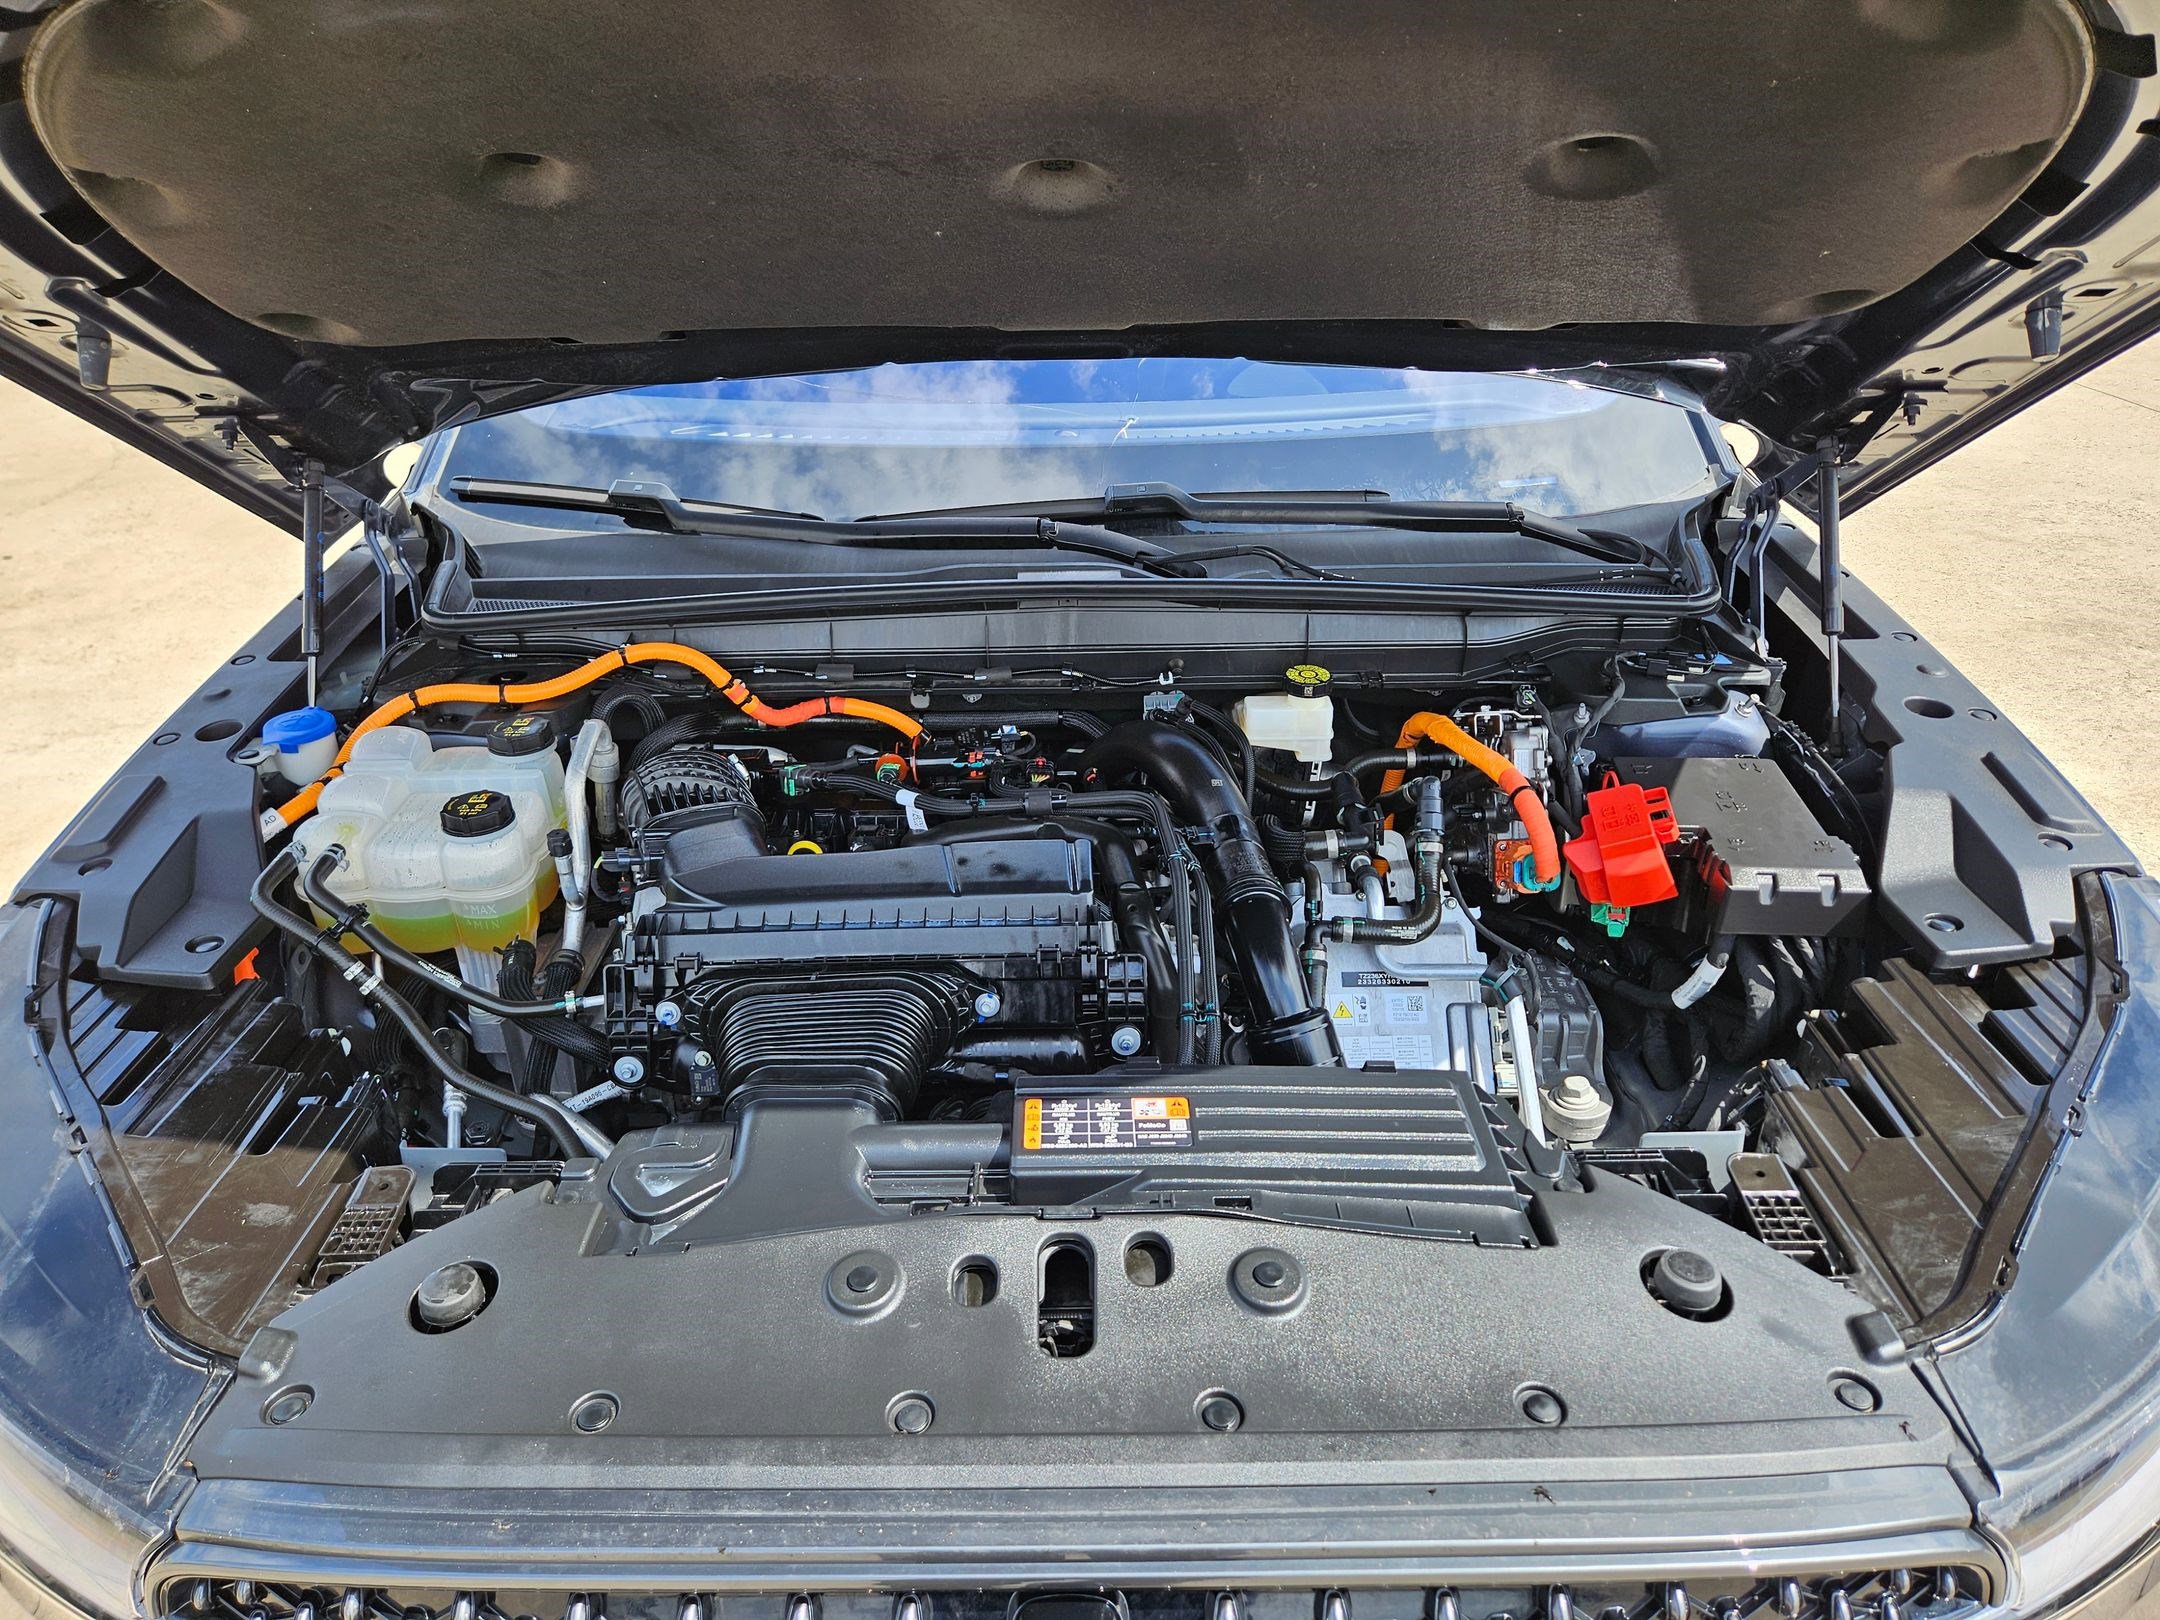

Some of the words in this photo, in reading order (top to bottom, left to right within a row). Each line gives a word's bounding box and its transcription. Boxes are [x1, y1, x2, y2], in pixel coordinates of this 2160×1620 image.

[264, 815, 277, 827] AD
[469, 903, 497, 915] MAX
[474, 919, 503, 929] MIN
